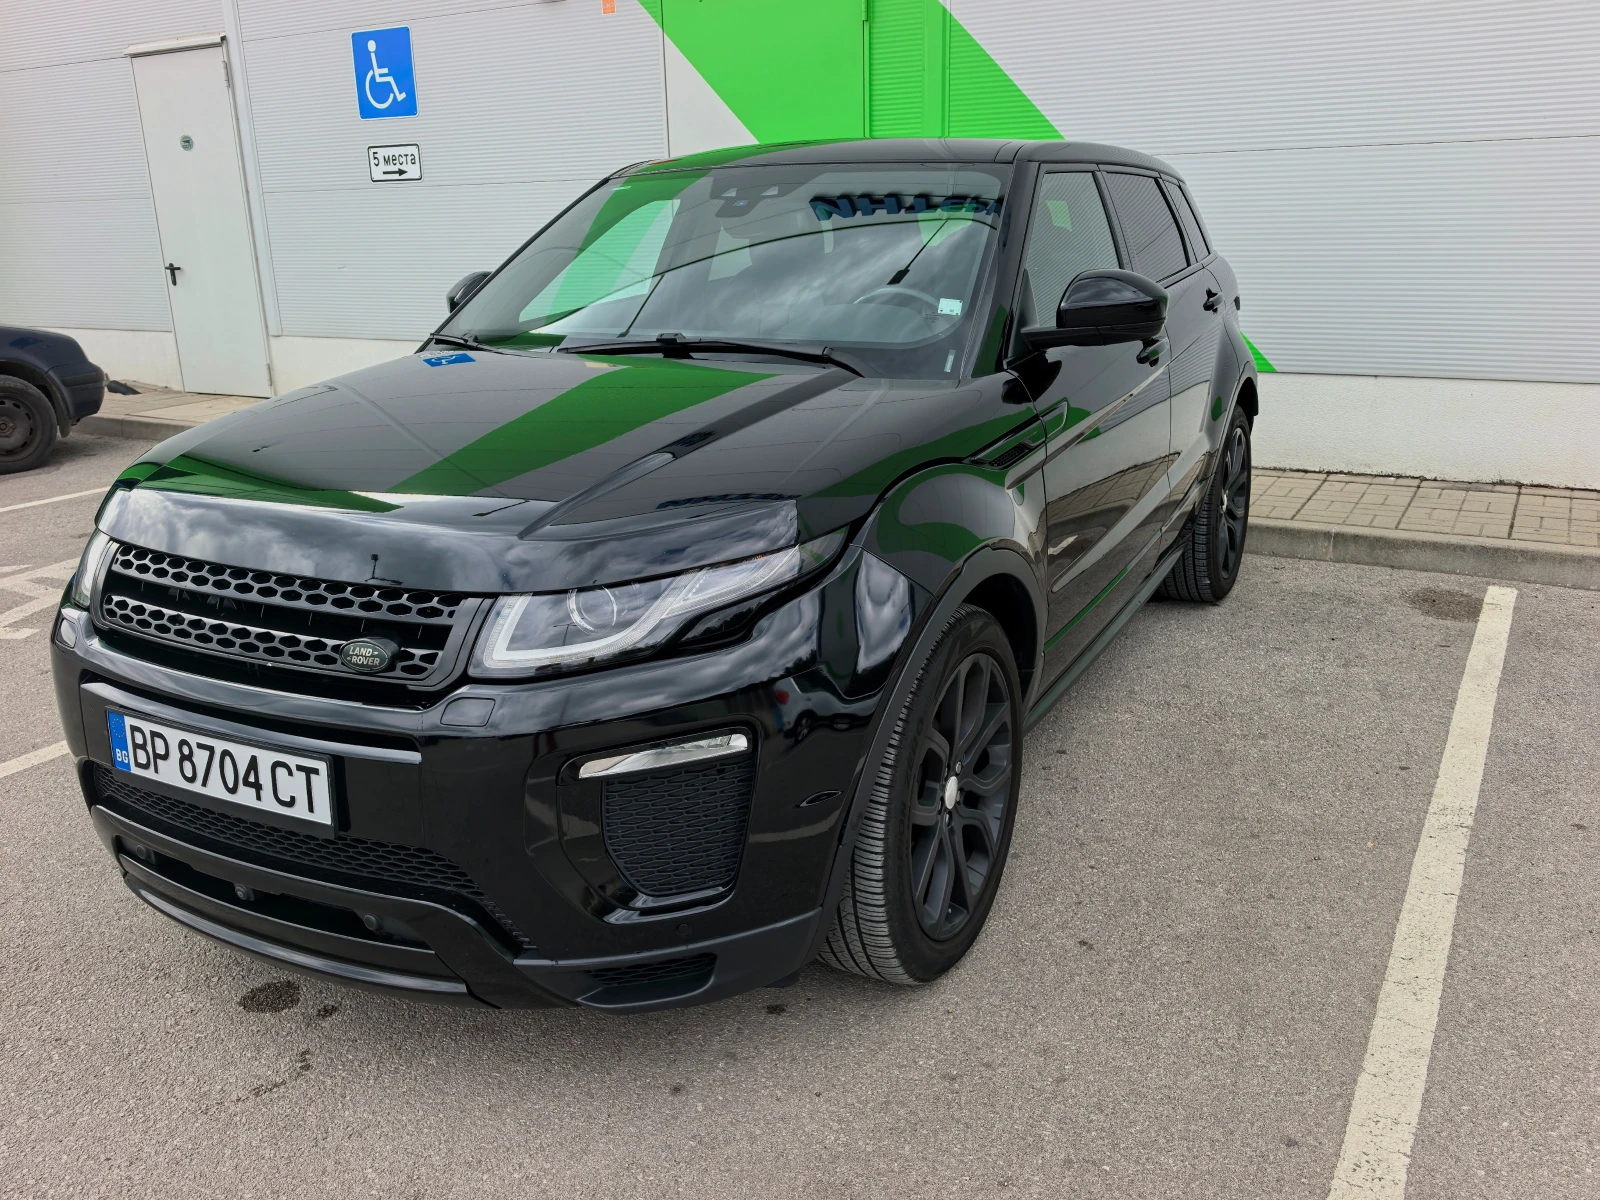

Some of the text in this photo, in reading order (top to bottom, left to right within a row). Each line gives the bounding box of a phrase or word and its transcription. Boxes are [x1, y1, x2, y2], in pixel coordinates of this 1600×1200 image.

[372, 152, 416, 166] 5 места
[115, 748, 129, 765] BG
